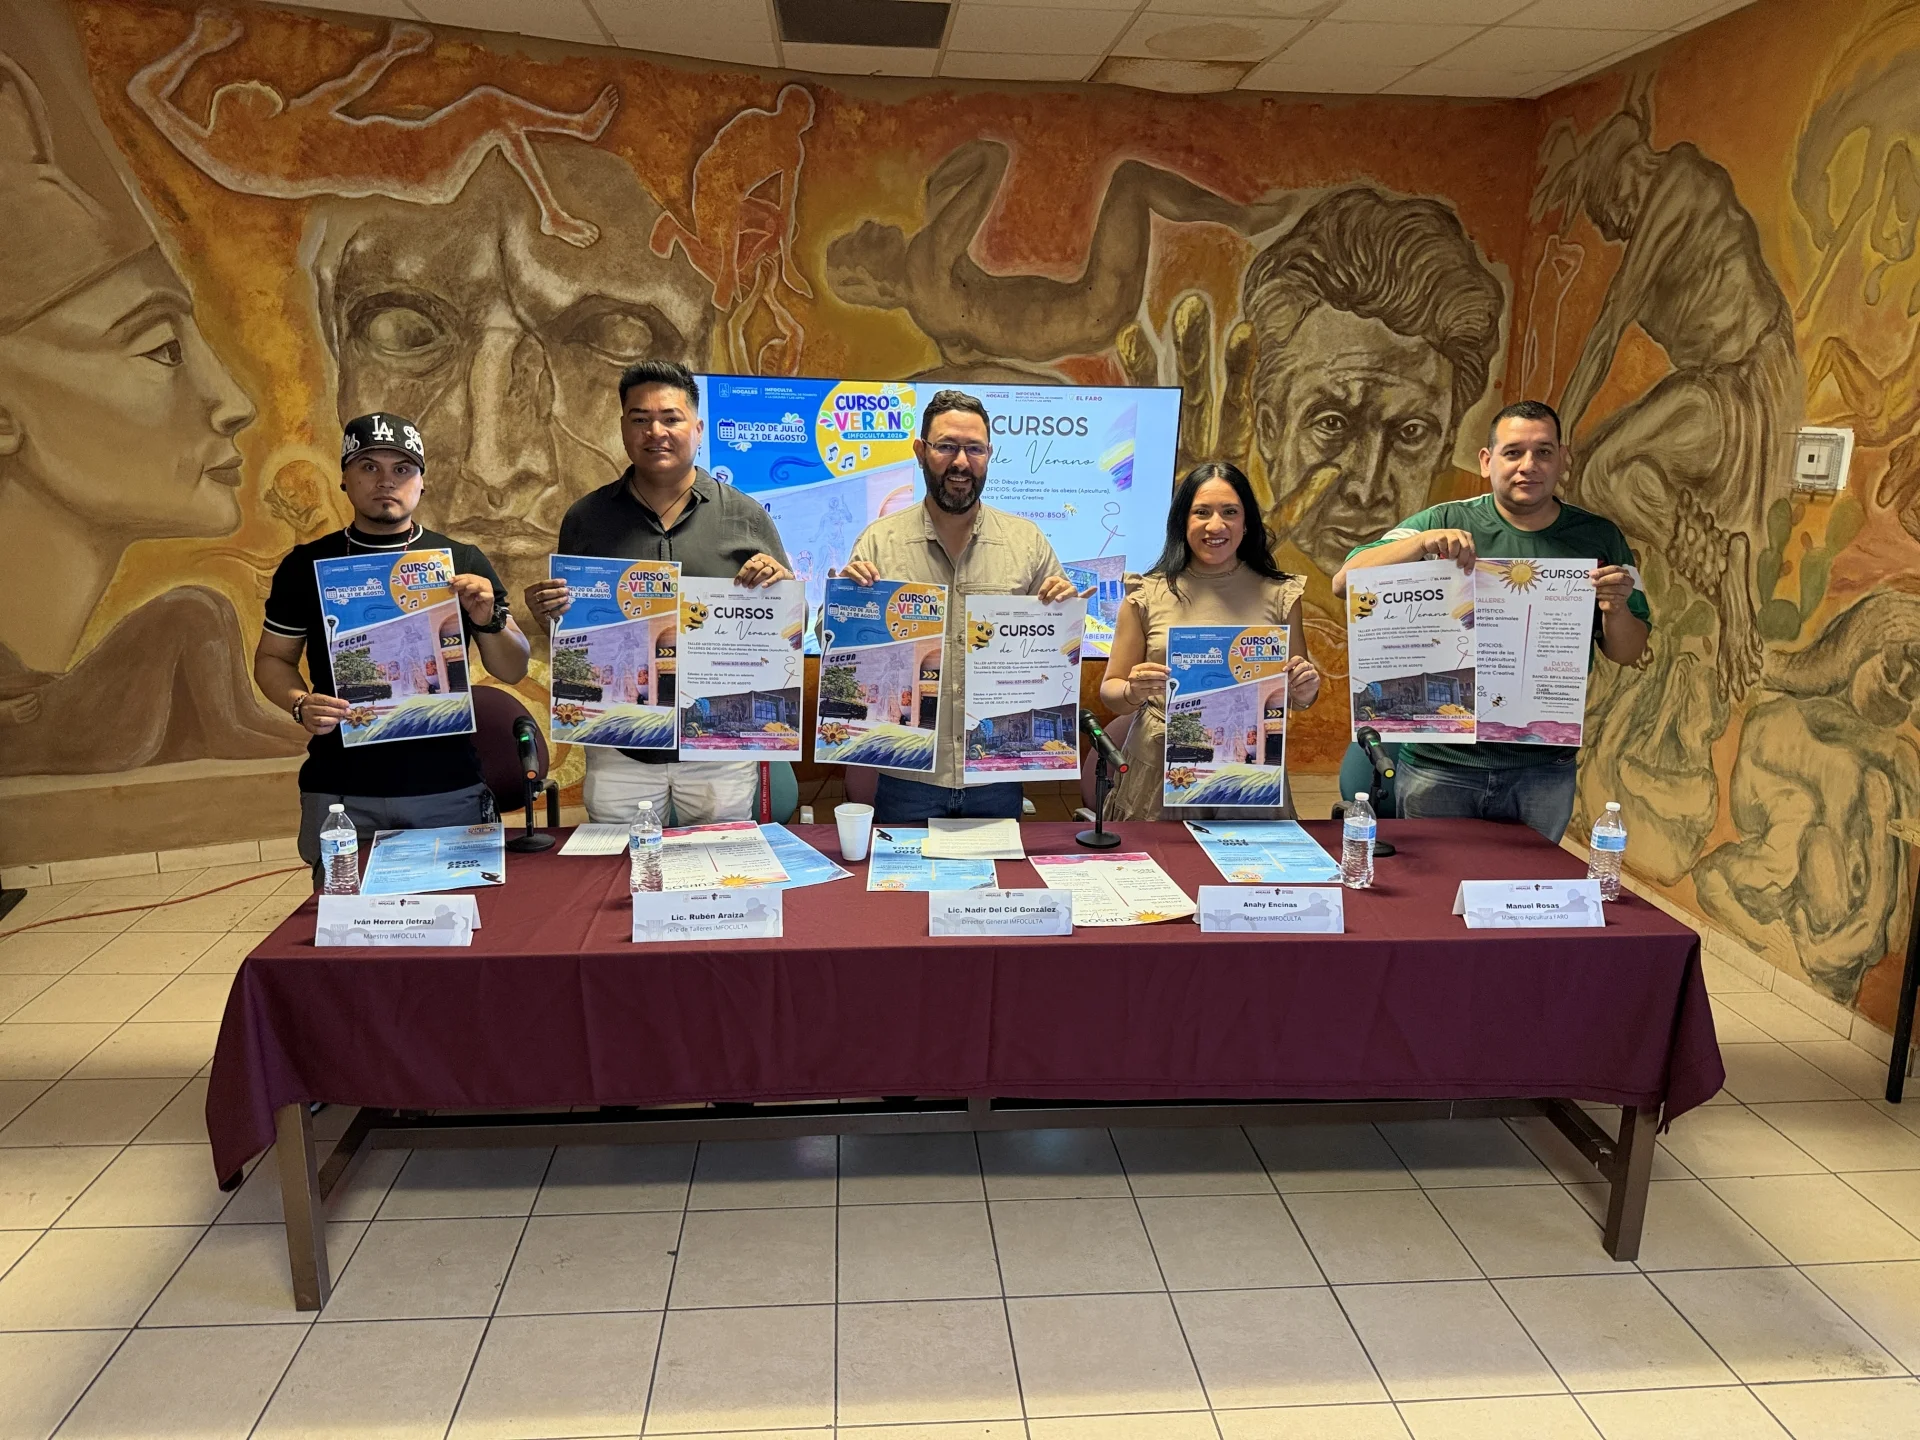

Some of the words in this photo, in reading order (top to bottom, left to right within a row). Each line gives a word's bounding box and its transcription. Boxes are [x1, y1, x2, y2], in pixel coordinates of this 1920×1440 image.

[836, 395, 889, 411] CURSO
[834, 411, 914, 431] VERANO
[991, 415, 1088, 436] CURSOS
[372, 415, 394, 442] LA
[768, 424, 778, 432] DE
[780, 425, 804, 433] JULIO
[762, 433, 772, 441] DE
[774, 434, 806, 442] AGOSTO
[991, 446, 1012, 465] de
[1025, 440, 1095, 474] Verano
[400, 562, 435, 573] CURSO
[400, 570, 452, 585] VERANO
[630, 572, 663, 581] CURSO
[1541, 570, 1589, 579] CURSOS
[628, 581, 678, 592] VERANO
[1547, 583, 1557, 592] de
[1564, 580, 1594, 595] Veran
[899, 594, 931, 603] CURSO
[1383, 589, 1444, 604] CURSOS
[714, 607, 774, 619] CURSOS
[897, 603, 945, 615] VERANO
[1384, 609, 1397, 621] de
[1406, 603, 1449, 623] Verano
[714, 624, 728, 635] de
[736, 621, 778, 640] Verano
[1000, 625, 1055, 636] CURSOS
[1241, 637, 1272, 645] CURSO
[1000, 642, 1012, 653] de
[1020, 638, 1058, 658] Verano
[1239, 645, 1286, 657] VERANO
